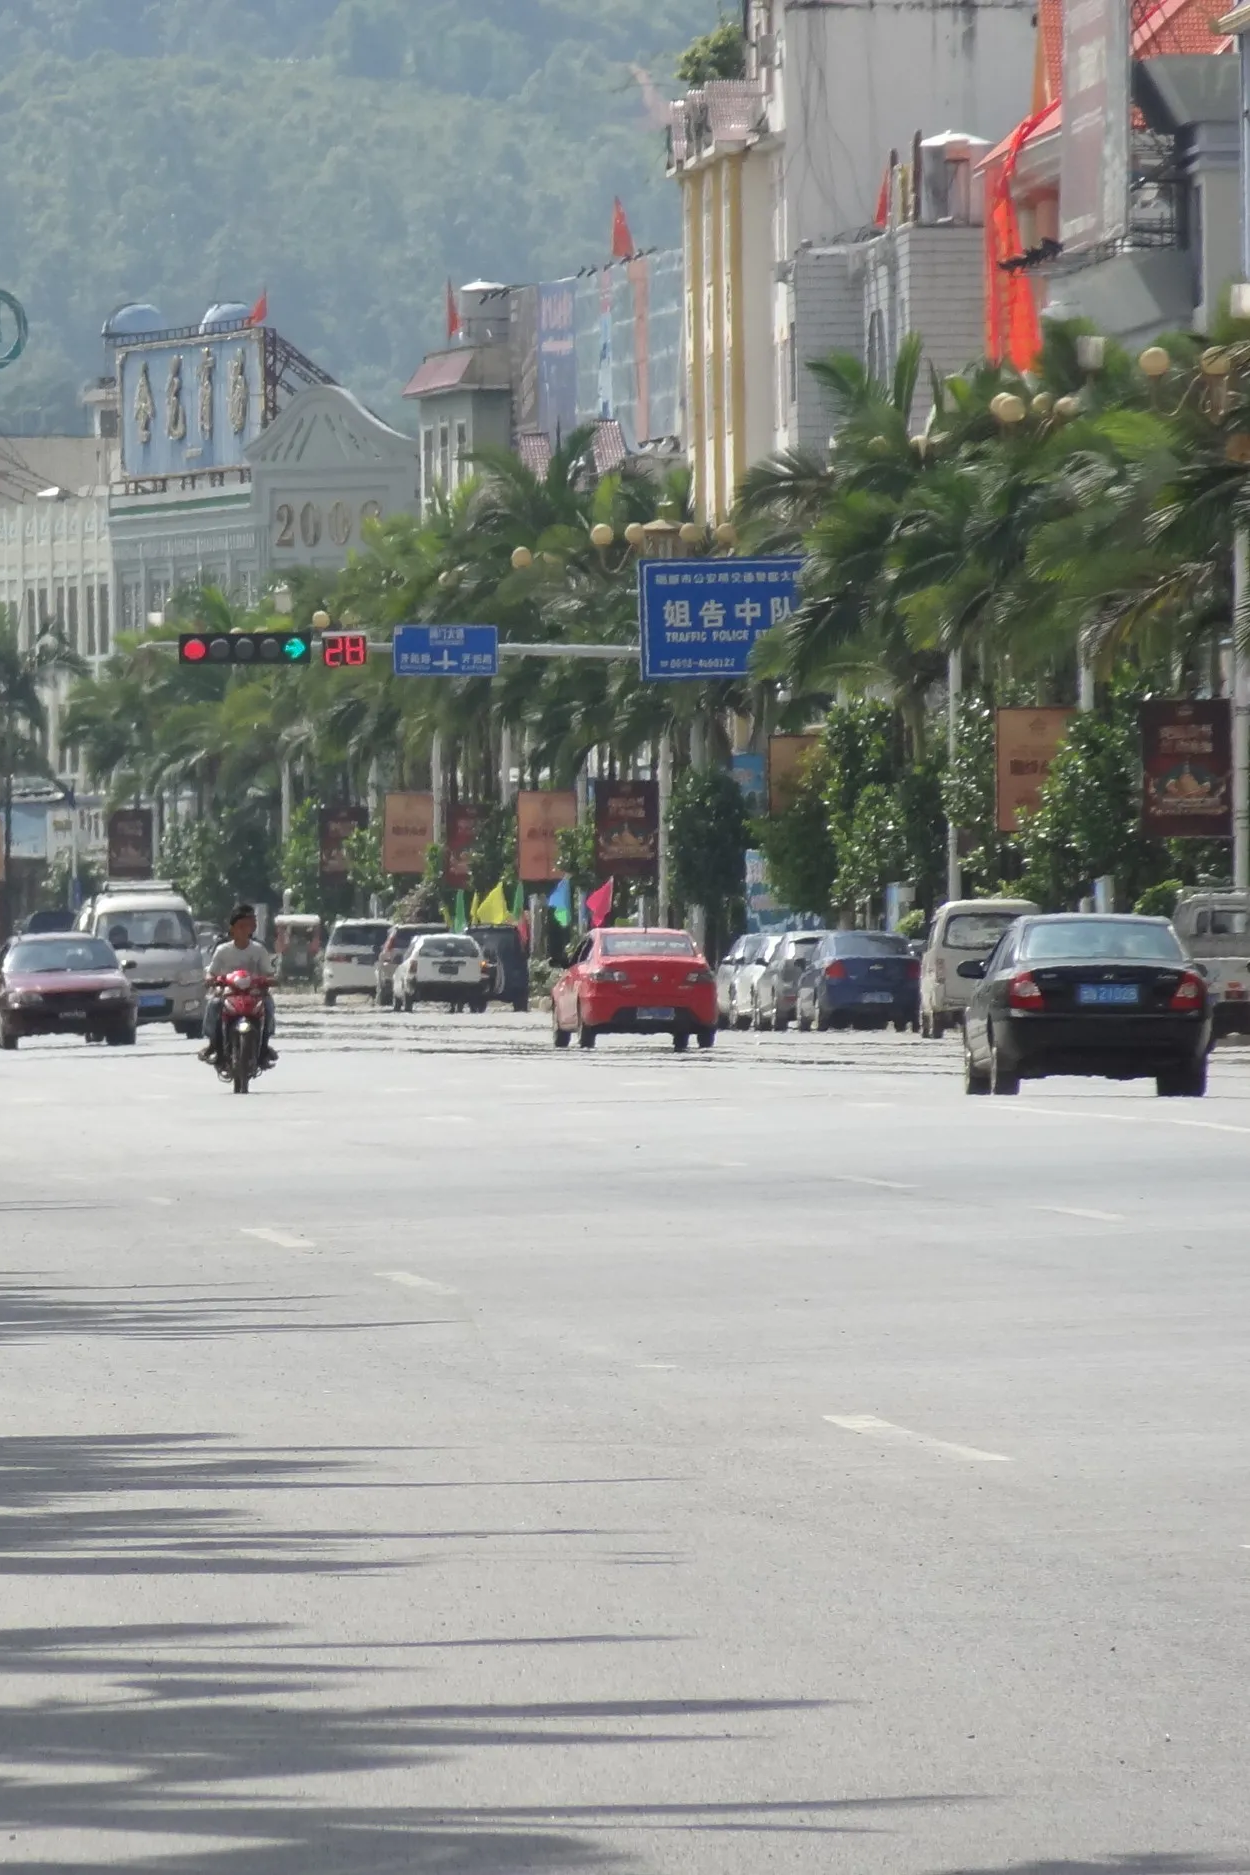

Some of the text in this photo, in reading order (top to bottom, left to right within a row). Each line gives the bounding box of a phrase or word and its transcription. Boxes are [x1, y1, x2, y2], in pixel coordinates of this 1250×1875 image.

[663, 597, 792, 628] 姐告中队
[325, 636, 364, 666] 28
[665, 631, 707, 643] TRAFFIC
[712, 630, 749, 642] POLICE
